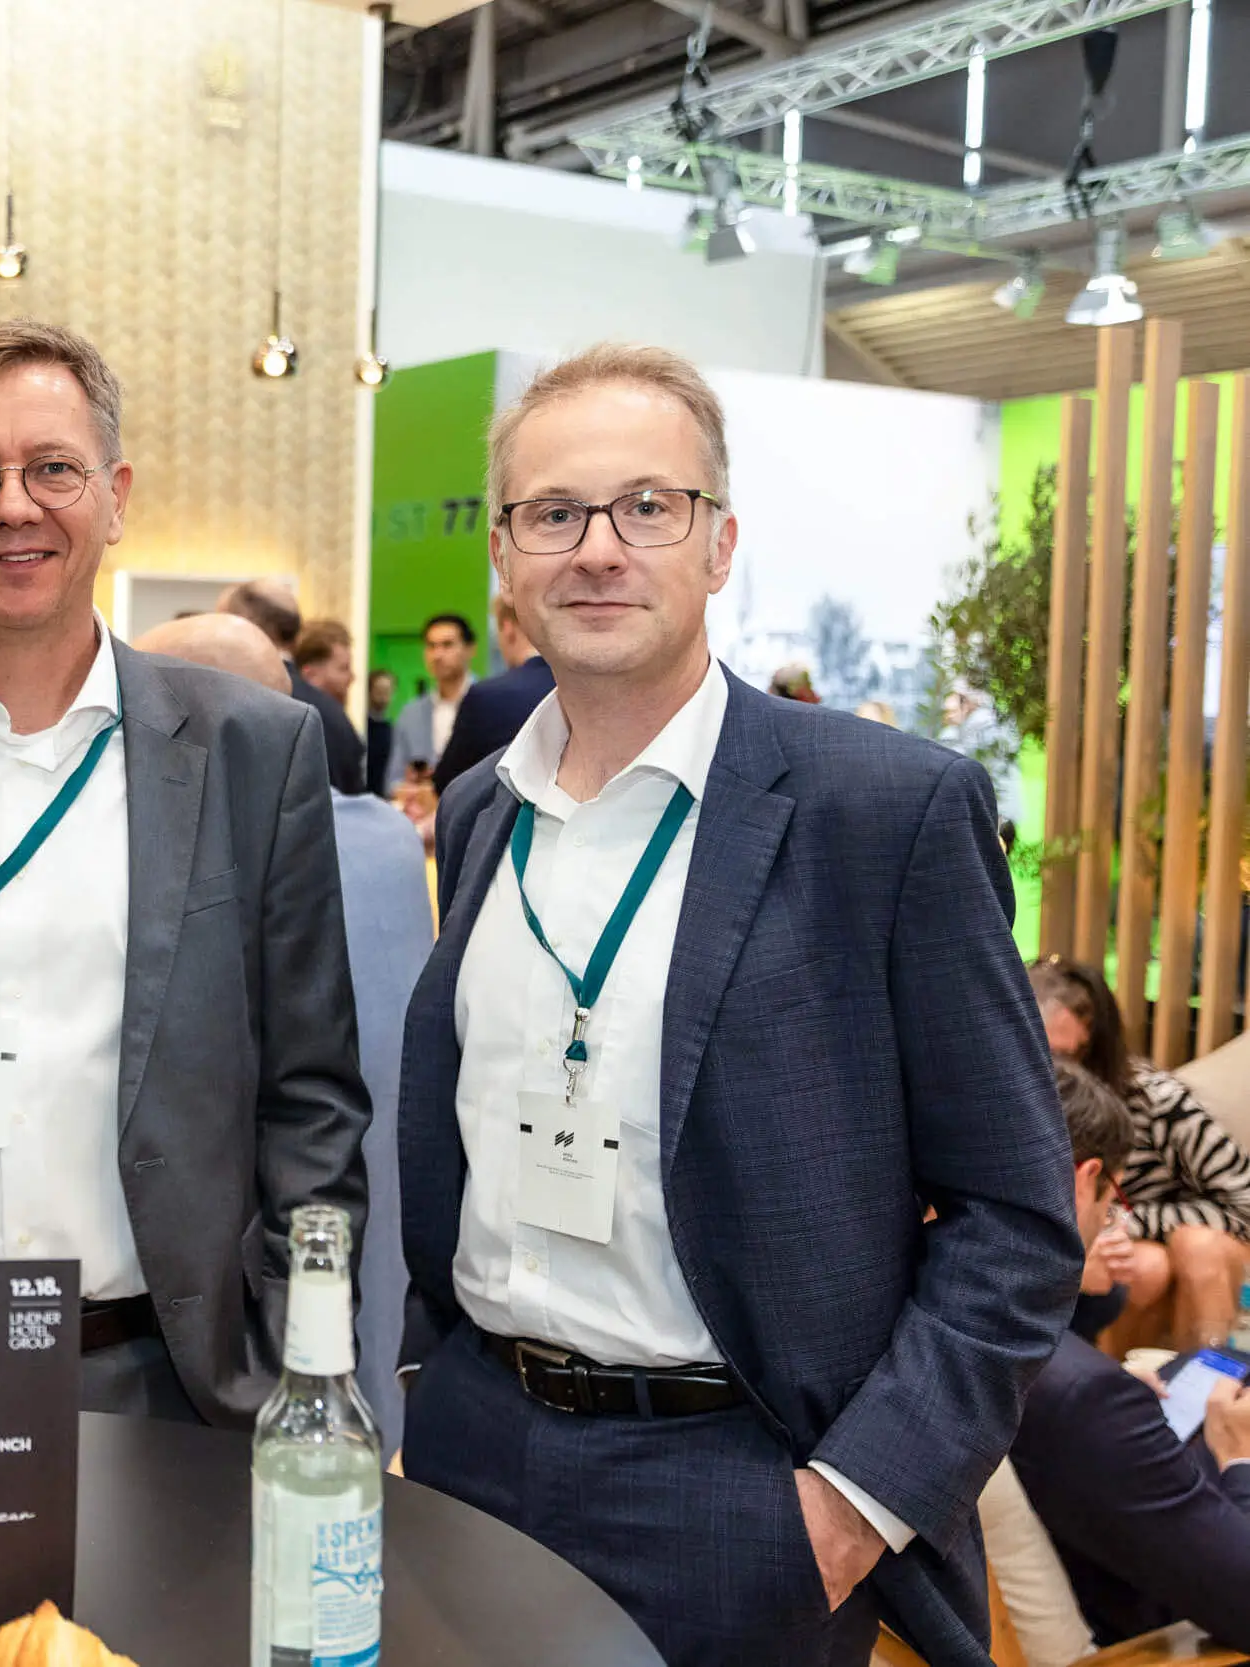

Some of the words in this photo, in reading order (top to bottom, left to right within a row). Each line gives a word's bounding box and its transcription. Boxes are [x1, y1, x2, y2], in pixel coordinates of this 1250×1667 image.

[442, 497, 483, 536] 77
[10, 1276, 62, 1297] 12.18.
[8, 1311, 62, 1326] LINDNER
[8, 1325, 49, 1338] HOTEL
[8, 1336, 56, 1351] GROUP
